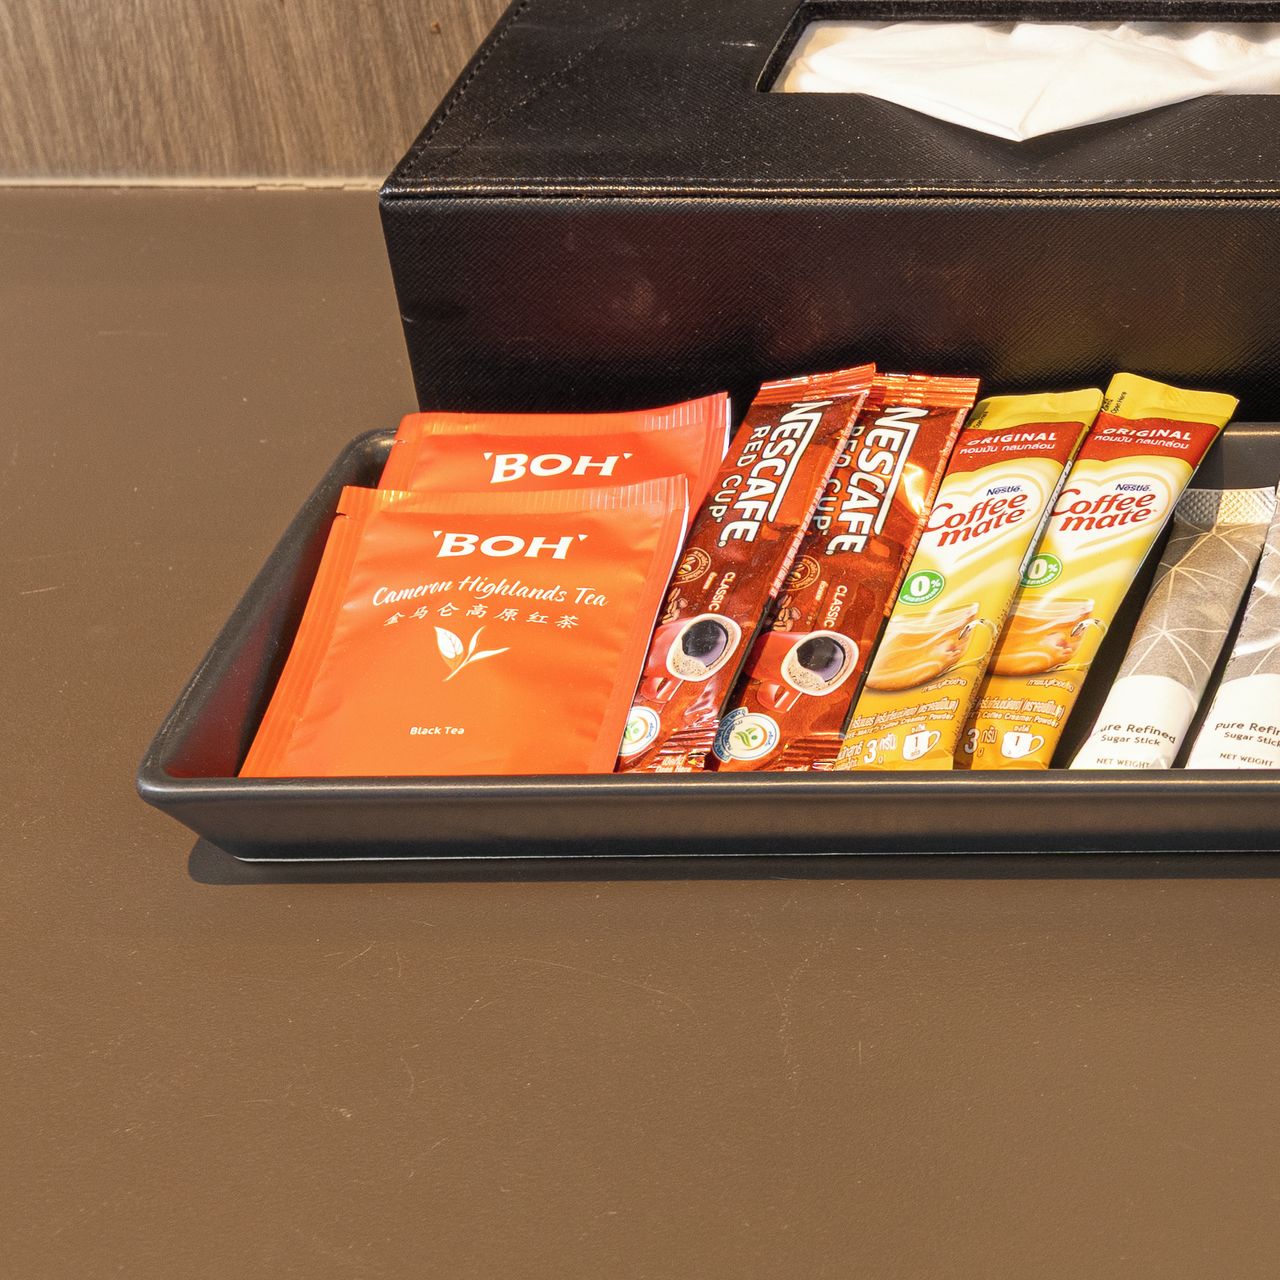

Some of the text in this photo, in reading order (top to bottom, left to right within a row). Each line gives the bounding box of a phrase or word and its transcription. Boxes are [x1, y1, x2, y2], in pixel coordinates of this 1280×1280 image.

[967, 432, 1057, 445] ORIGINAL
[1103, 428, 1191, 440] ORIGINAL
[709, 425, 771, 518] RED CUP
[925, 494, 1028, 532] Coffee
[1051, 488, 1156, 517] Coffee
[937, 509, 1026, 547] mate
[1059, 507, 1152, 531] mate
[372, 576, 609, 607] Cameron Highlands Tea
[708, 571, 736, 611] CLASSIC
[384, 602, 580, 629] 金马仑高原红茶
[824, 584, 848, 628] CLASSIC
[410, 726, 465, 736] Black Tea
[964, 728, 980, 754] 3
[1101, 734, 1161, 746] Sugar Stick
[1126, 724, 1177, 744] Refined
[1223, 731, 1253, 742] Sugar
[864, 739, 878, 764] 3
[1096, 757, 1115, 765] NET
[1219, 752, 1275, 767] NET WEIGHT
